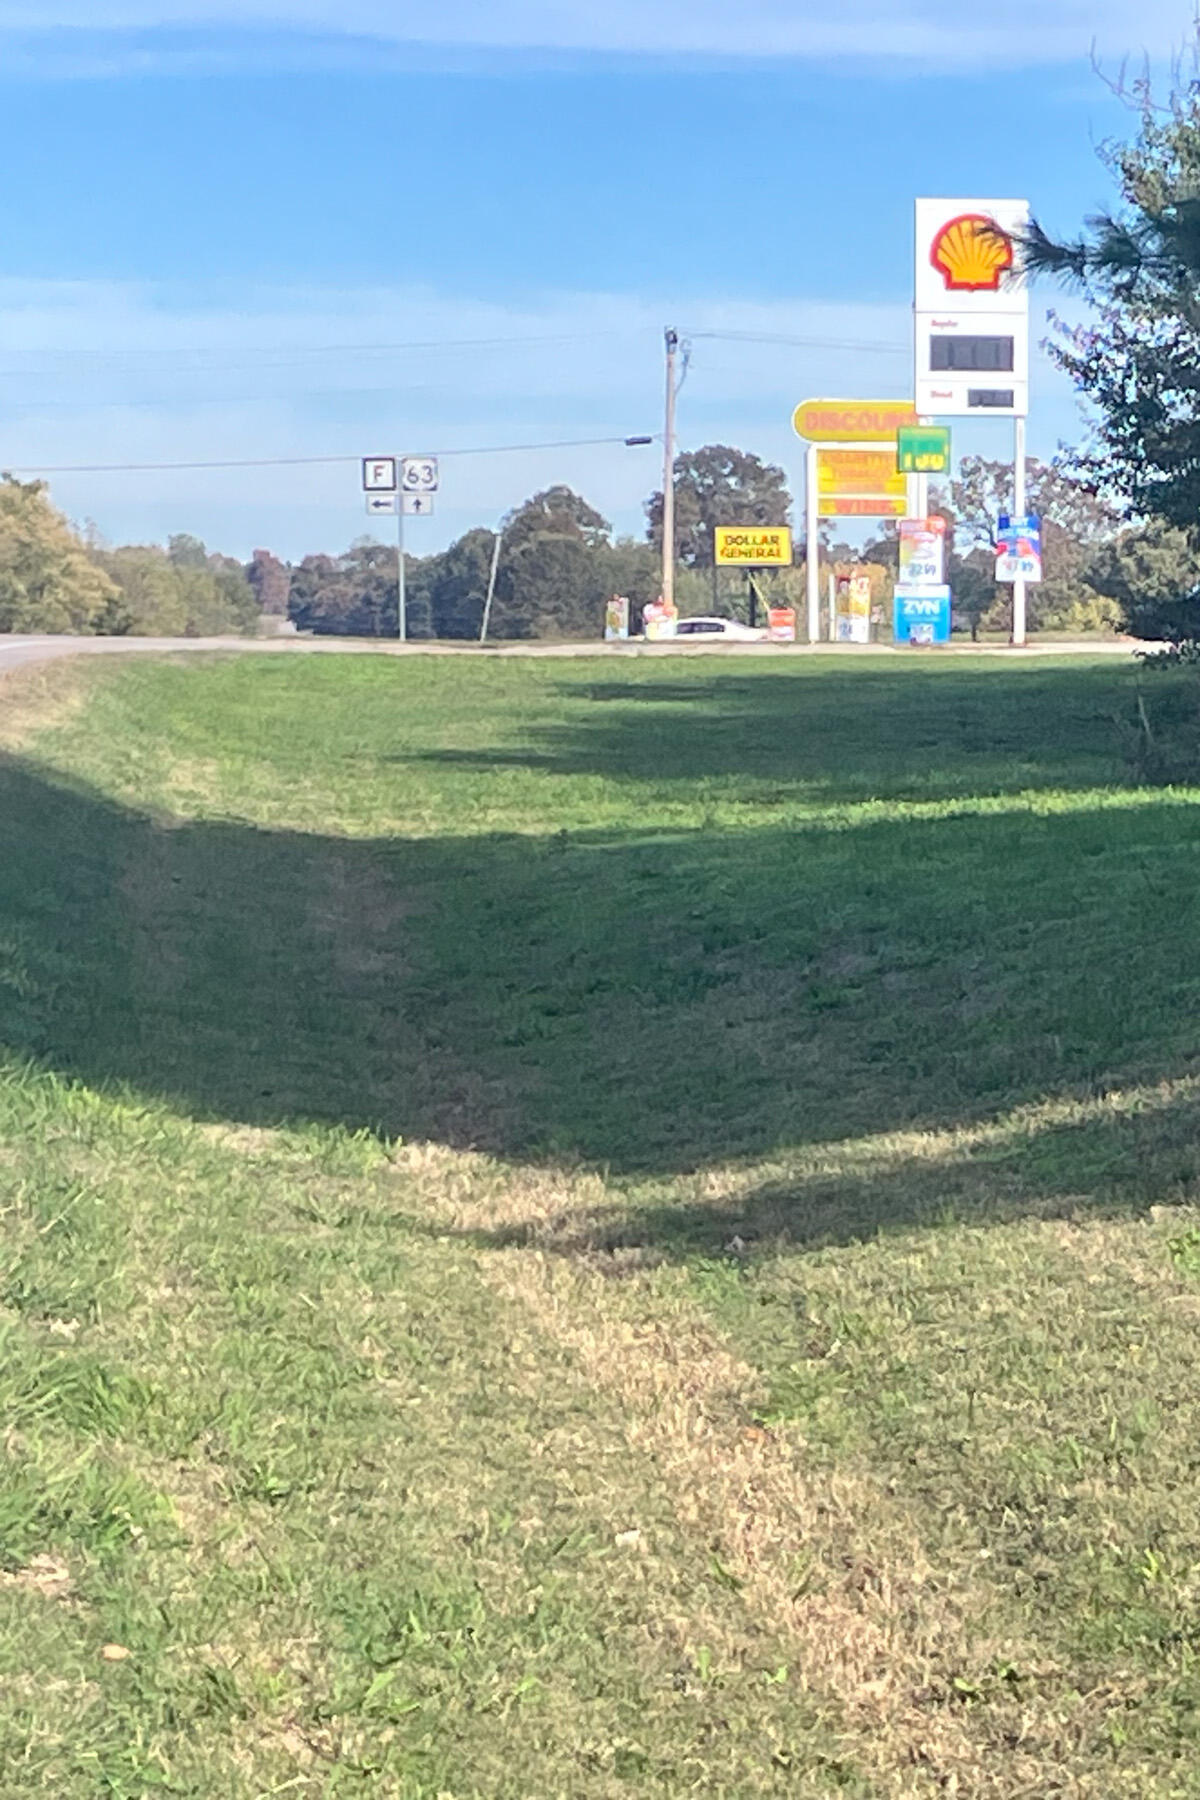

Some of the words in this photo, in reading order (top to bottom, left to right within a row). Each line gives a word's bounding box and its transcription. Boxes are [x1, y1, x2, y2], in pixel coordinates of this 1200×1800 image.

[374, 465, 385, 483] F
[407, 465, 433, 484] 63
[724, 535, 780, 546] DOLLAR
[720, 548, 782, 558] GENERAL
[903, 599, 940, 615] ZYN
